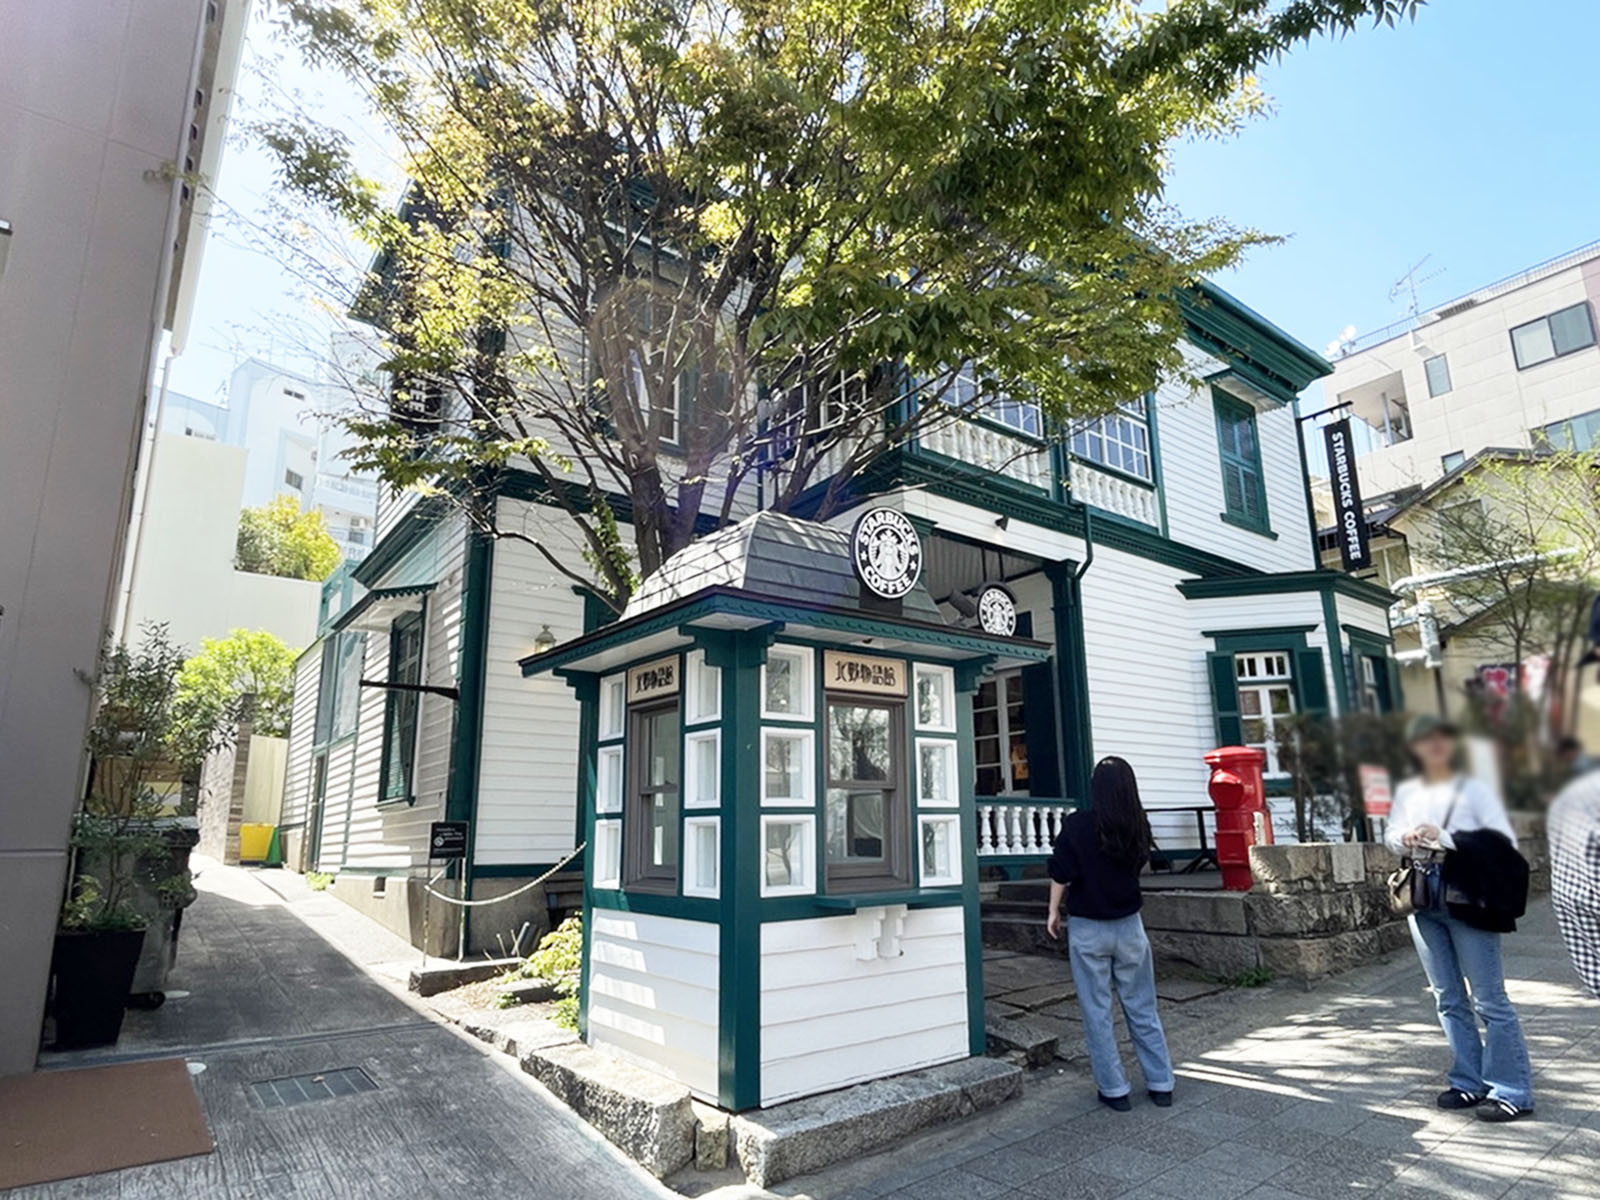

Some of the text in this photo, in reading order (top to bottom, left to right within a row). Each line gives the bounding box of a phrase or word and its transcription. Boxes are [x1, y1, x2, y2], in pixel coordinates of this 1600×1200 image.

[1331, 431, 1362, 561] STARBUCKS COFFEE
[860, 511, 919, 556] STARBUCKS
[864, 565, 912, 594] COFFEE
